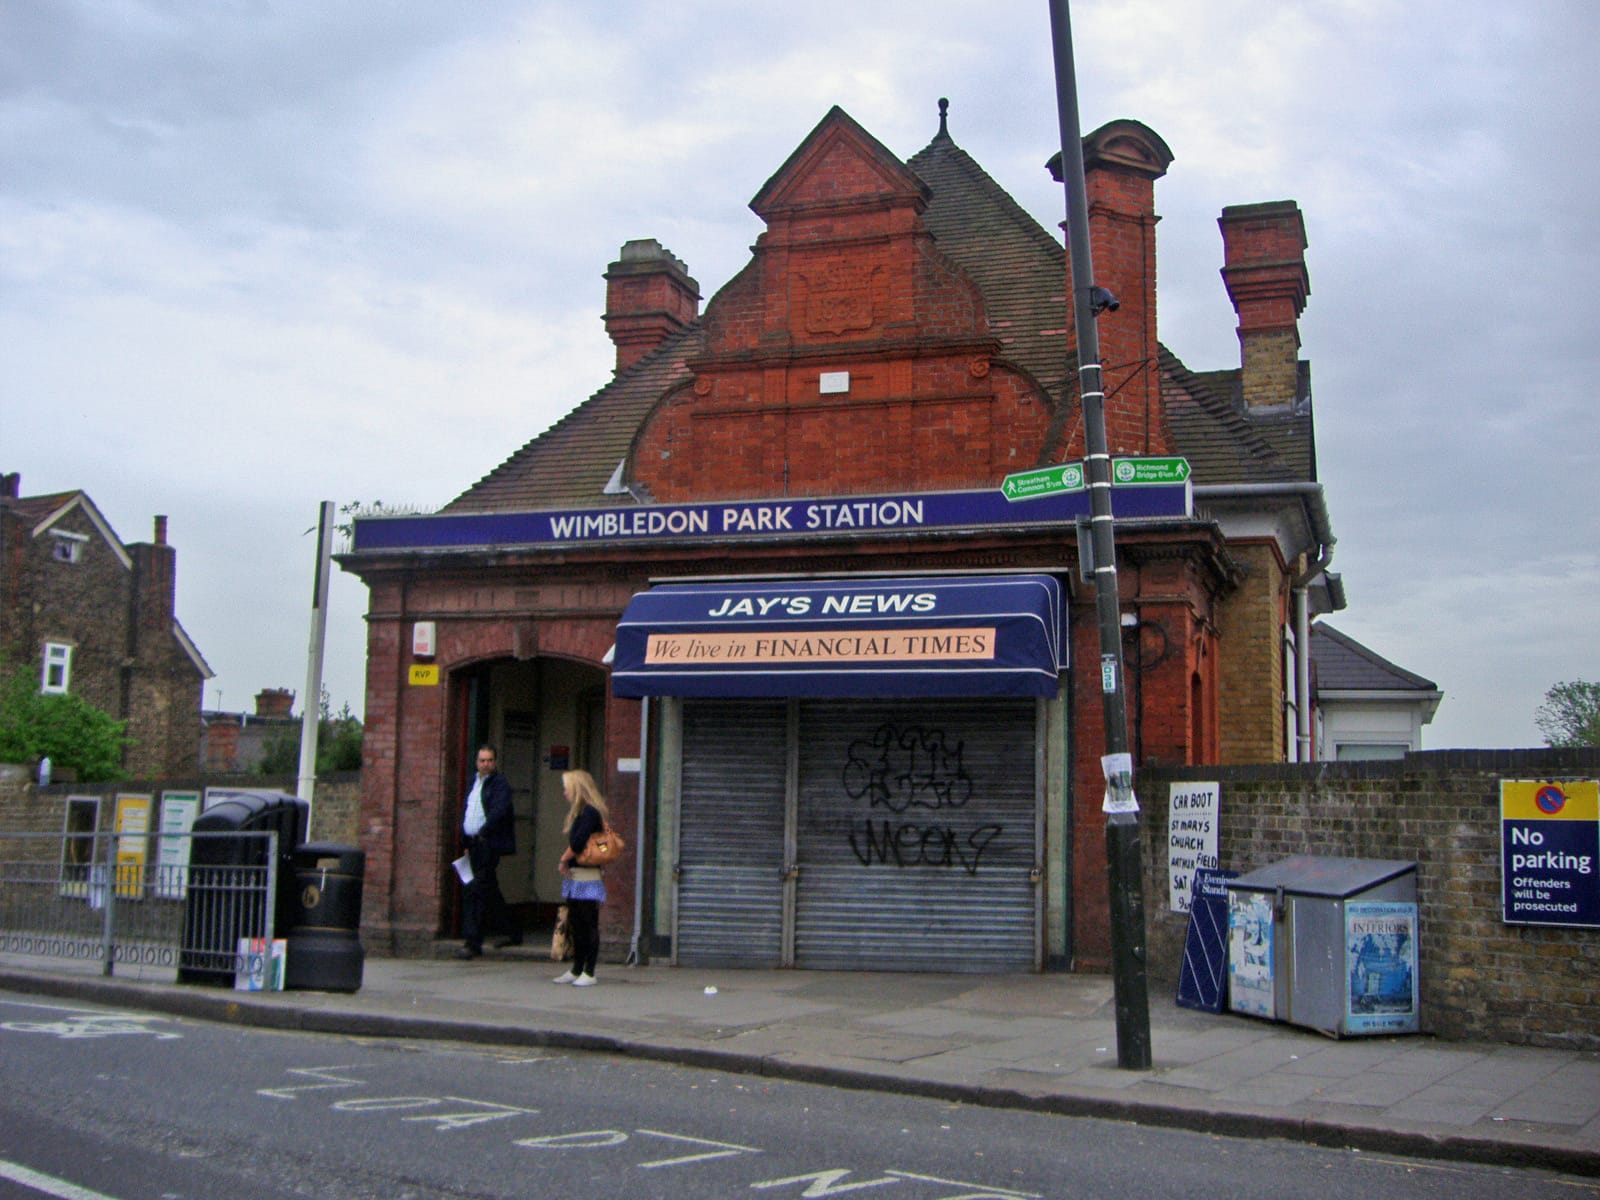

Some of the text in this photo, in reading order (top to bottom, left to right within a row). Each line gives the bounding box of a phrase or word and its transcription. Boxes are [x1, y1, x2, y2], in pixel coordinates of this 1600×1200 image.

[1136, 463, 1169, 471] Richmond
[1017, 475, 1050, 486] Streatham
[1136, 471, 1157, 479] Bridge
[1018, 483, 1045, 493] Common
[550, 500, 923, 538] WIMBLEDON PARK STATION
[708, 593, 937, 617] JAY'S NEWS
[653, 635, 986, 658] We live in FINANCIAL TIMES
[1173, 792, 1213, 810] CAR BOOT
[1171, 820, 1179, 831] ST
[1512, 827, 1544, 845] No
[1171, 835, 1204, 851] CHURCH
[1171, 853, 1217, 870] ARTHUR FIELD
[1512, 851, 1591, 874] parking
[1174, 875, 1188, 890] SAT
[1204, 873, 1231, 885] Evenin
[1513, 877, 1571, 889] Offenders
[1513, 889, 1550, 900] will be
[1513, 902, 1577, 912] prosecuted
[1353, 922, 1409, 933] INTERIORS
